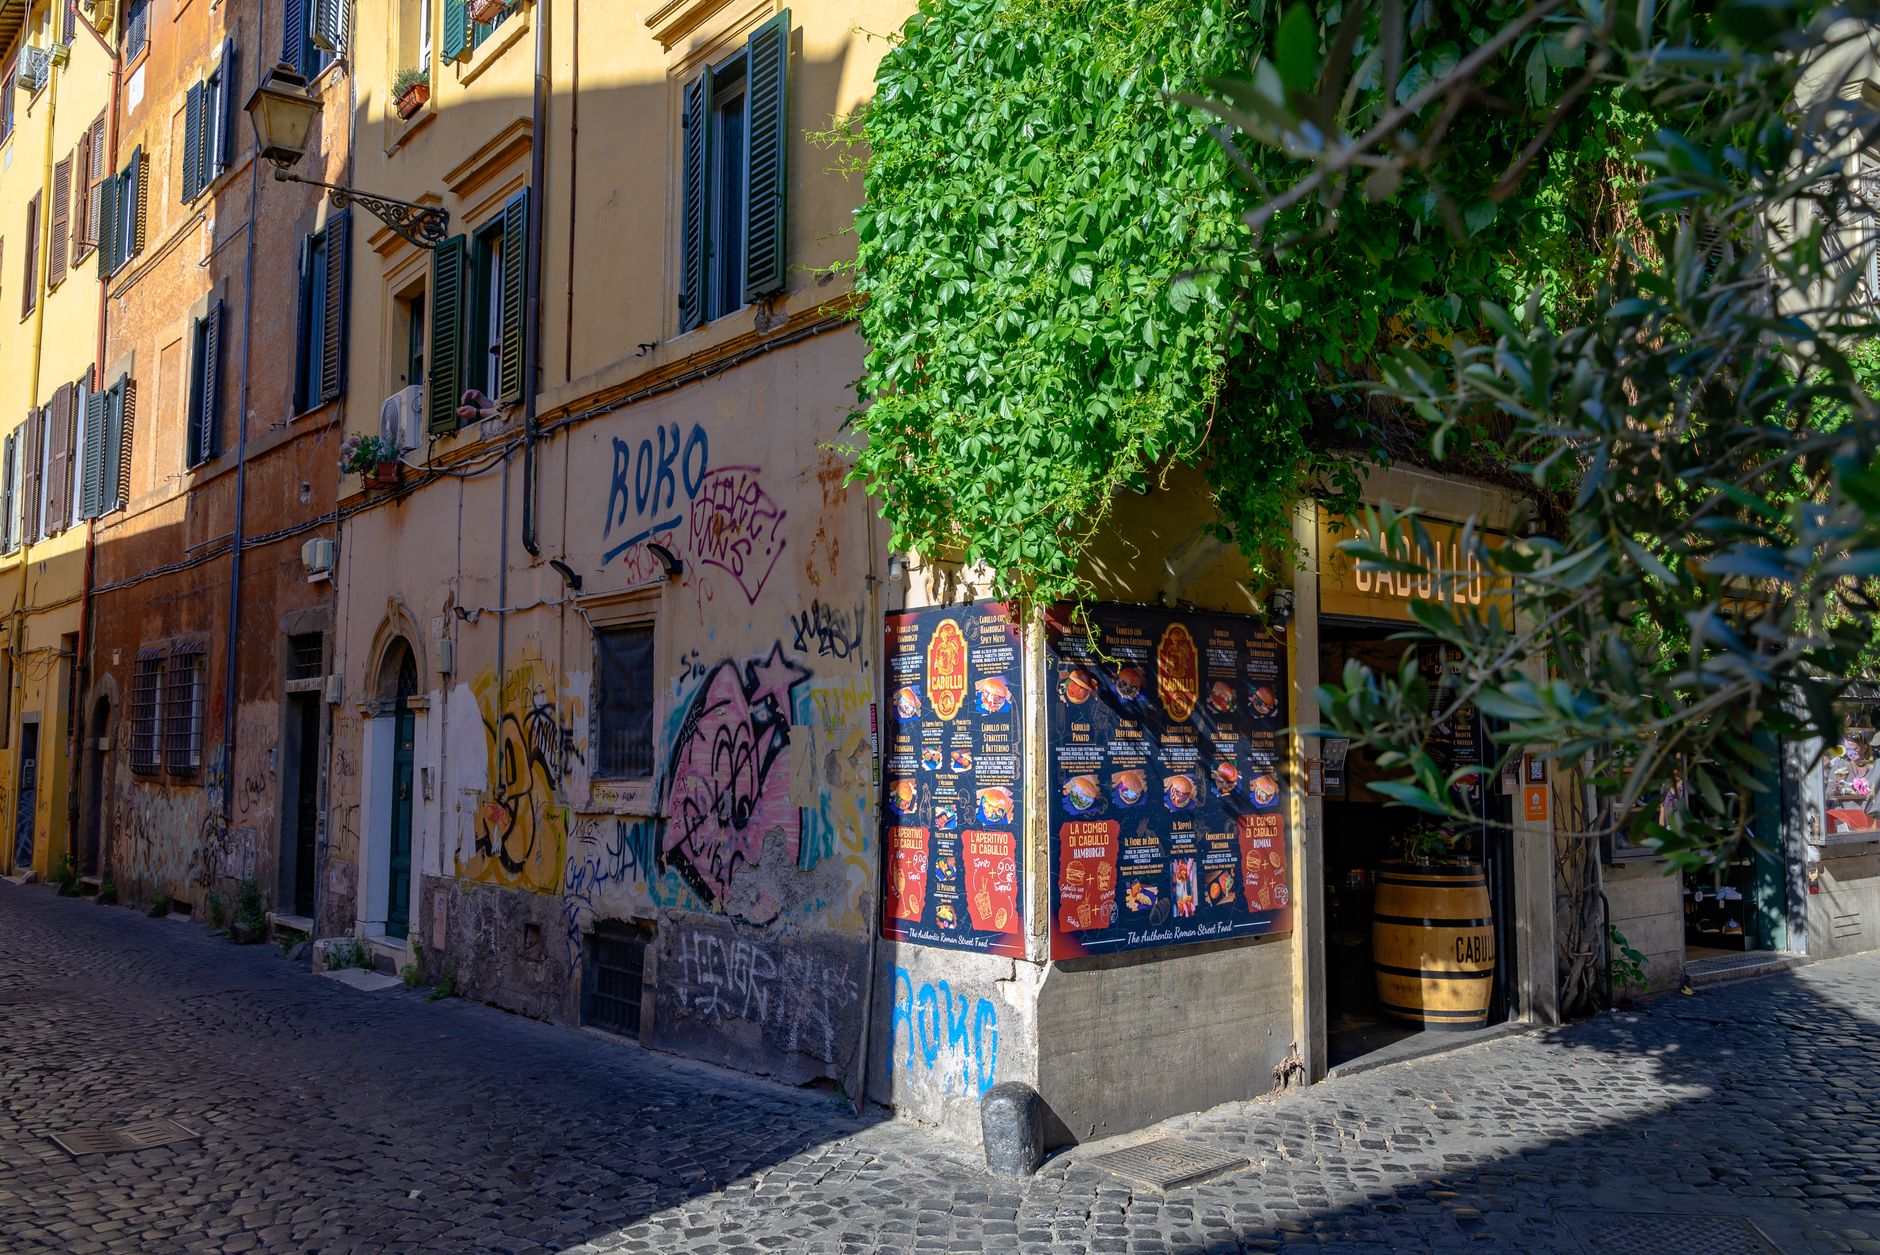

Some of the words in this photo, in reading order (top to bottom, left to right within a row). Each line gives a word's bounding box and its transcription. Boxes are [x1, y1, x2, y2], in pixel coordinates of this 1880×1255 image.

[932, 674, 962, 690] CABULLO
[1163, 677, 1194, 691] CABULLO
[982, 723, 999, 732] CABULLO
[1000, 724, 1010, 732] CON
[1071, 722, 1090, 732] CABULLO
[983, 734, 1008, 742] STRACCETTI
[1246, 817, 1255, 827] LA
[1256, 816, 1277, 826] COMBO
[894, 827, 922, 839] L'APERITIVO
[1070, 823, 1080, 835] LA
[1082, 822, 1108, 834] COMBO
[1246, 829, 1252, 838] DI
[1253, 827, 1278, 838] CABULLO
[894, 839, 899, 848] DI
[900, 839, 922, 849] CABULLO
[970, 832, 1008, 844] L'APERITIVO
[1069, 835, 1077, 847] DI
[1078, 834, 1109, 847] CABULLO
[970, 844, 978, 853] DI
[979, 844, 1008, 856] CABULLO
[1073, 847, 1106, 859] HAMBURGER
[909, 928, 918, 937] The
[918, 930, 940, 941] Authentic
[940, 935, 957, 944] Roman
[958, 935, 974, 947] Street
[975, 938, 988, 948] Food
[1128, 931, 1139, 945] The
[1140, 928, 1173, 942] Authentic
[1174, 927, 1196, 939] Roman
[1198, 923, 1216, 936] Street
[1217, 921, 1233, 932] Food
